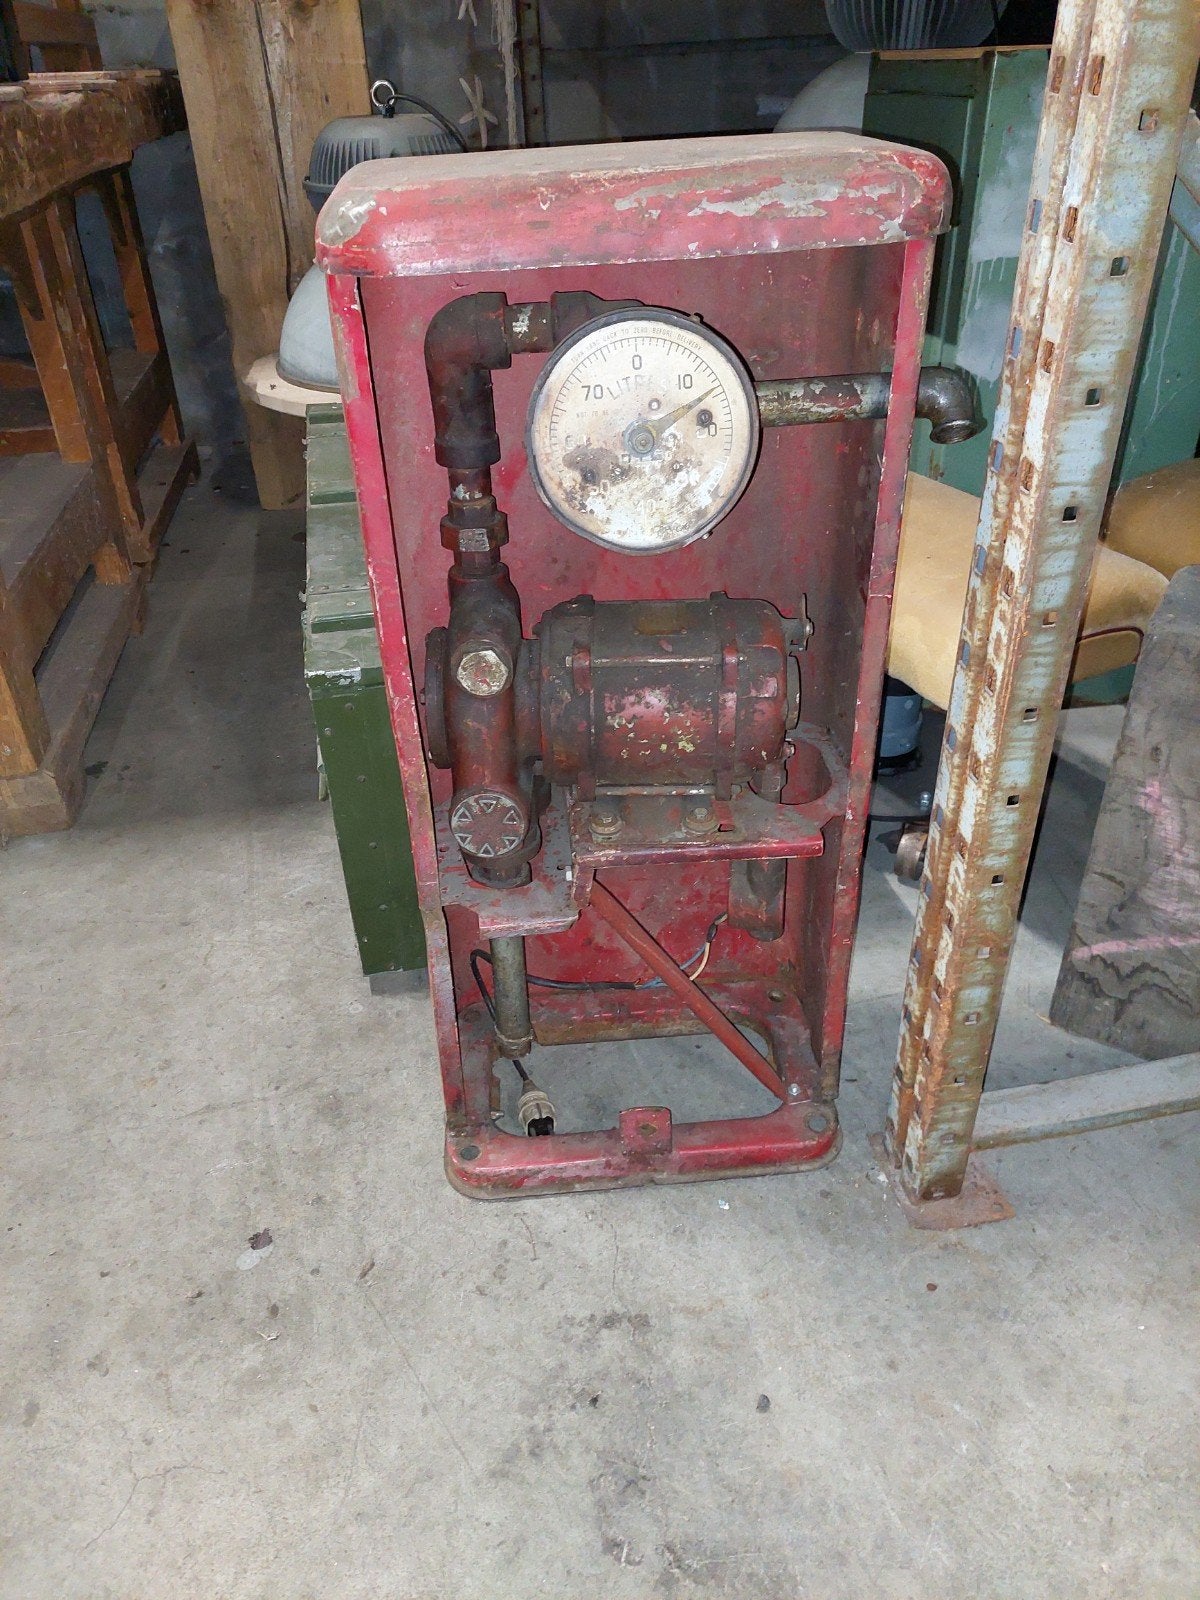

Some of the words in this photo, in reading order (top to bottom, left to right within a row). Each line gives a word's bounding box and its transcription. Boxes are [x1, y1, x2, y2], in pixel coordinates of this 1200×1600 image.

[633, 326, 648, 334] ZERO
[652, 327, 673, 338] BEFORE
[677, 334, 704, 350] DELIVERY
[631, 354, 643, 371] 0
[677, 373, 694, 390] 10
[581, 383, 604, 401] 70
